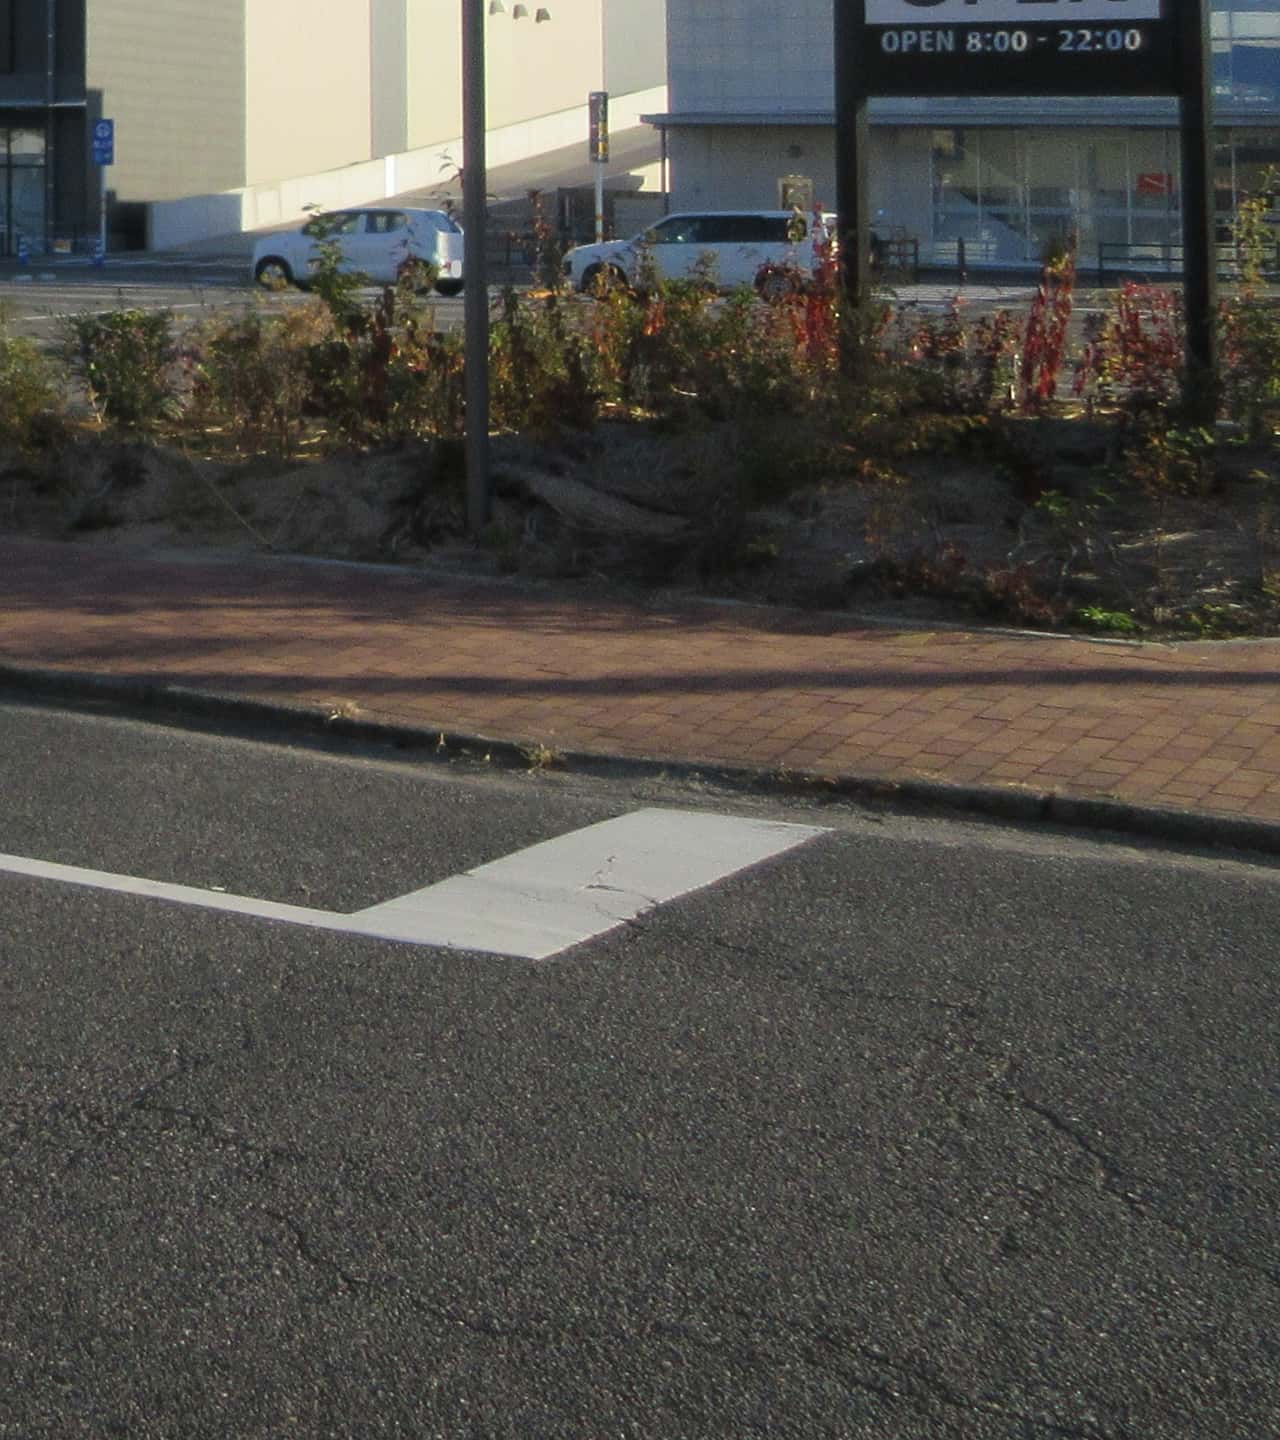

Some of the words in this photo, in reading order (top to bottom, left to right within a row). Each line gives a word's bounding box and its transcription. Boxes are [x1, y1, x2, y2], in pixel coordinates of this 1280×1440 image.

[881, 30, 955, 52] OPEN
[966, 30, 1028, 52] 8:00
[1057, 29, 1142, 51] 22:00
